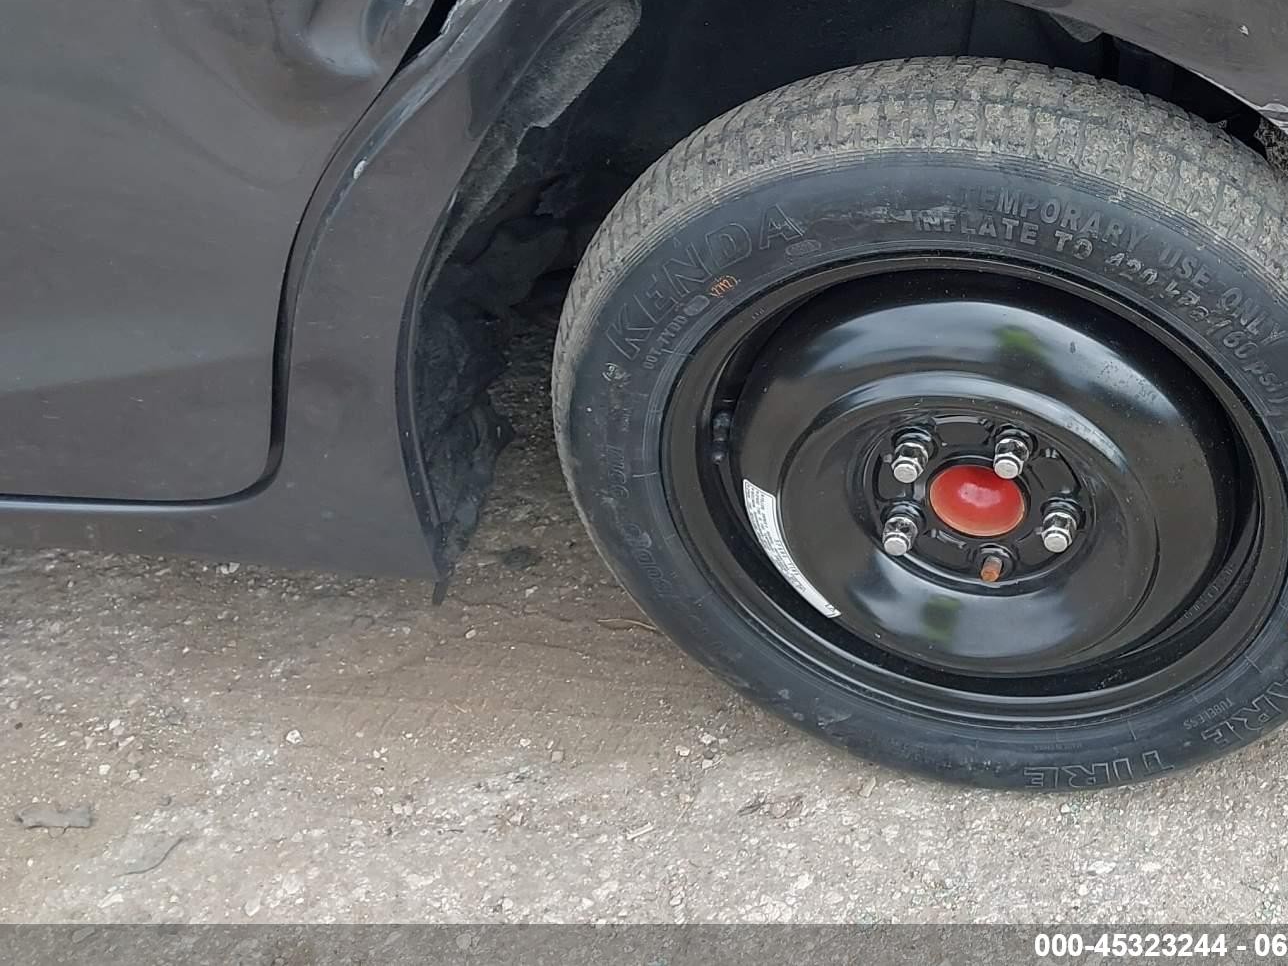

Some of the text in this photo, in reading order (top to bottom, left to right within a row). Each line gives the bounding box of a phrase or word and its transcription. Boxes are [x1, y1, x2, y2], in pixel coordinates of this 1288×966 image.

[604, 202, 806, 362] KENDA
[911, 205, 1039, 246] INFLATE
[1054, 229, 1093, 260] TO
[1104, 250, 1159, 287] 420
[959, 183, 1288, 347] TEMPORARY USE ONLY
[1183, 697, 1234, 731] TUBELESS
[1023, 748, 1174, 789] TIRE
